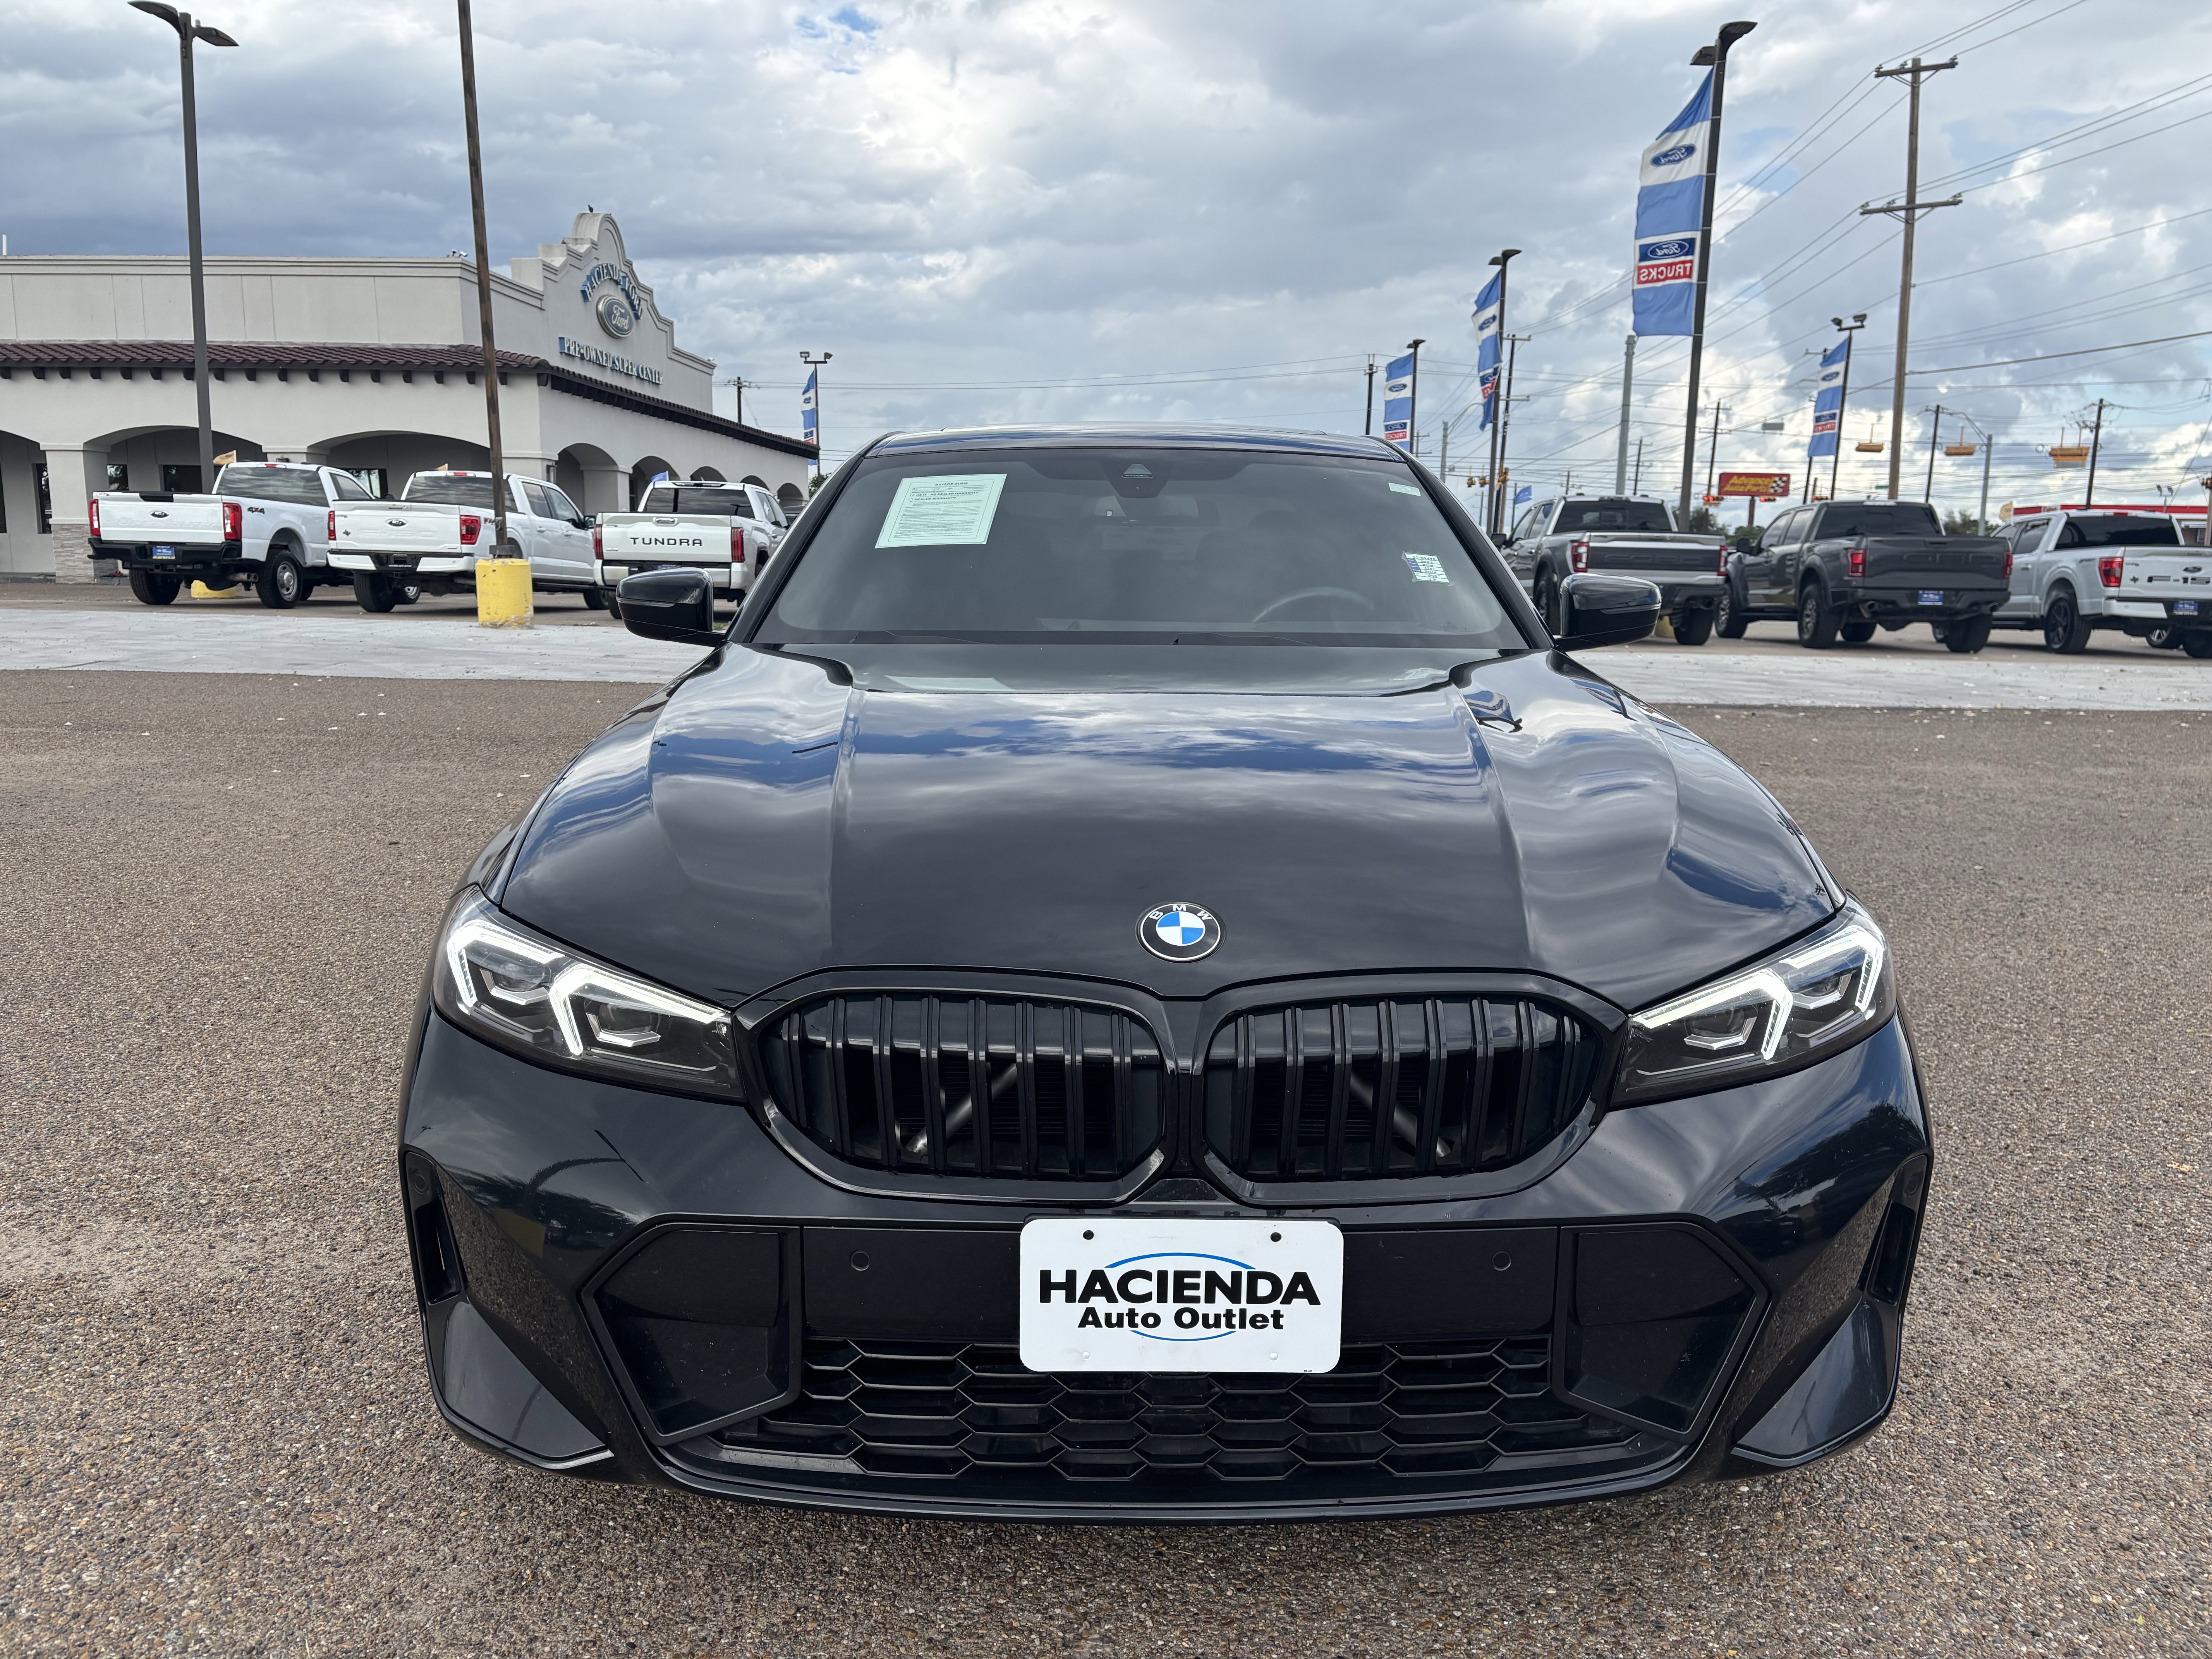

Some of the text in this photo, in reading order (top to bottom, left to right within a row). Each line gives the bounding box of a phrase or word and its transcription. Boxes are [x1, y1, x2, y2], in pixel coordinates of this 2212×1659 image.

[582, 263, 623, 301] HACIENDA
[563, 337, 663, 385] PRE-OWNED SUPER CENTER
[629, 537, 702, 546] TUNDRA
[1149, 905, 1212, 921] BMW
[1039, 1269, 1321, 1305] HACIENDA
[1078, 1307, 1285, 1330] Auto Outlet
